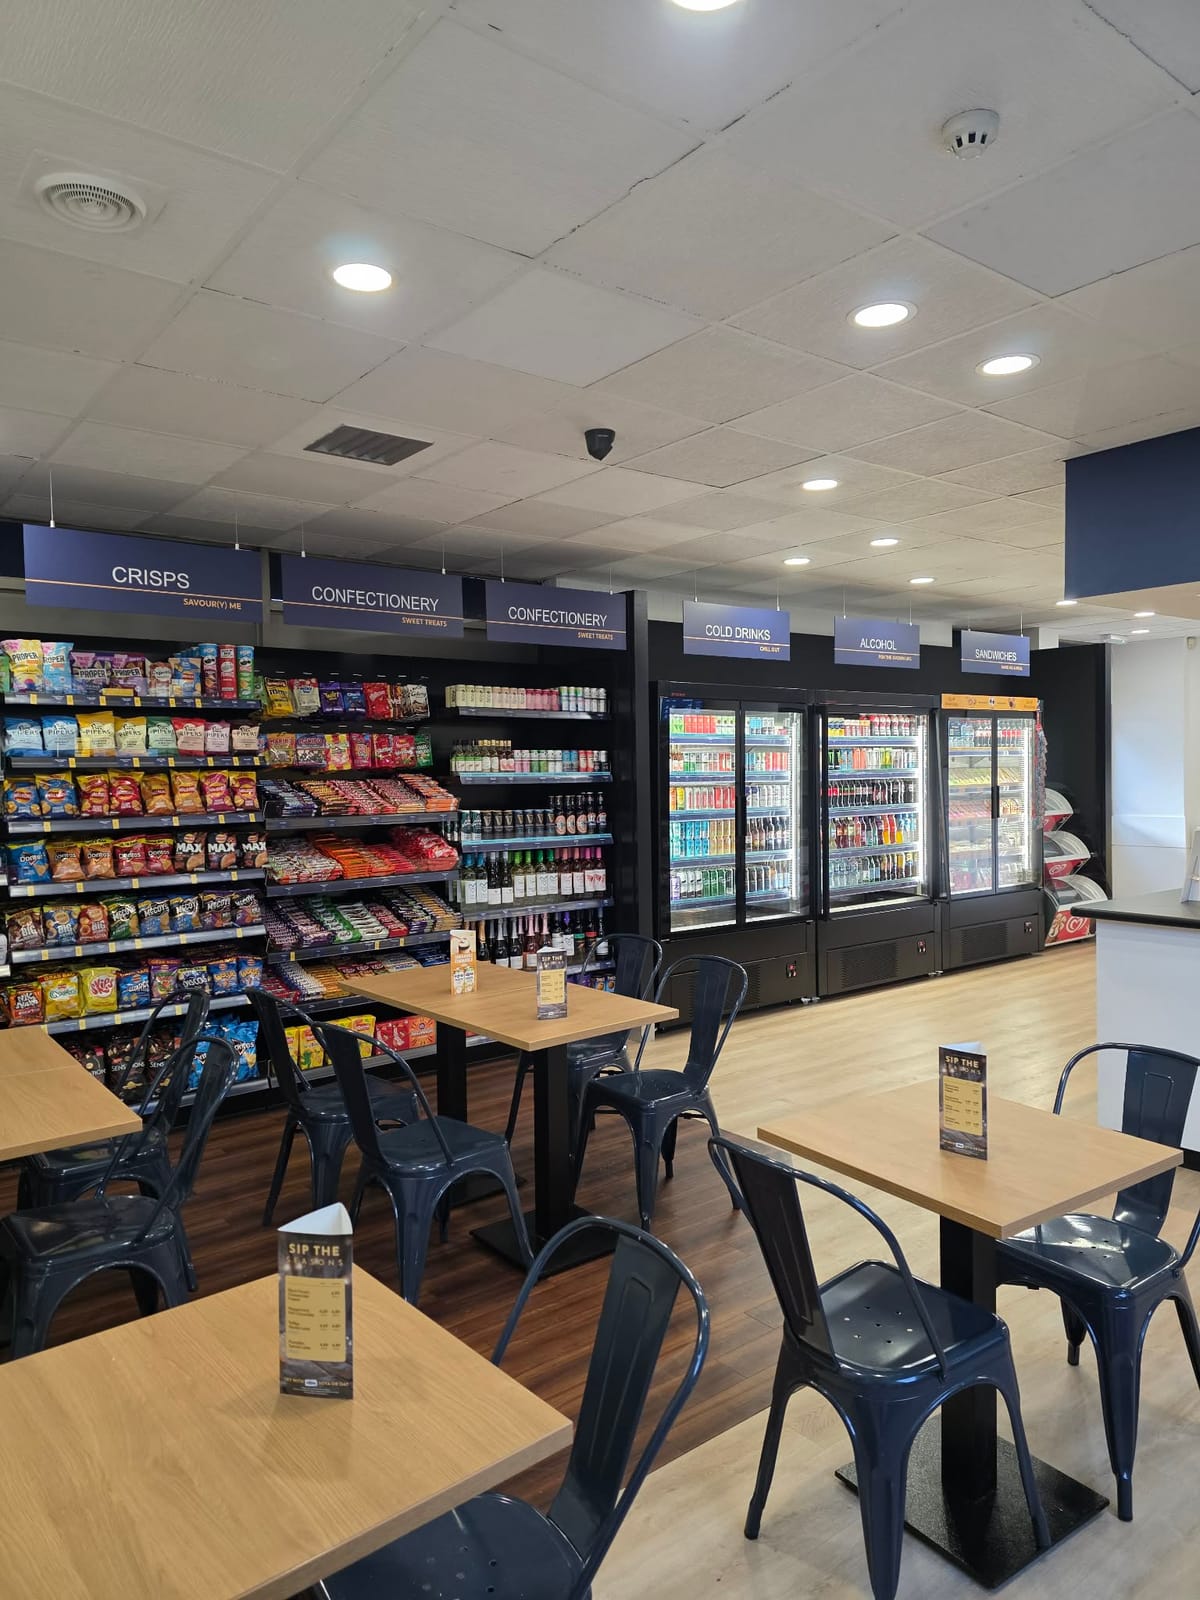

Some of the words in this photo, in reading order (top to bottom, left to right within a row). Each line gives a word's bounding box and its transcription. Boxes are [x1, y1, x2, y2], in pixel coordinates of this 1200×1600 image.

[112, 566, 190, 589] CRISPS
[183, 598, 228, 610] SAVOUR(Y)
[229, 602, 242, 610] ME
[311, 586, 439, 612] CONFECTIONERY
[402, 616, 423, 626] SWEET
[425, 618, 448, 627] TREATS
[508, 606, 608, 627] CONFECTIONERY
[577, 631, 596, 639] SWEET
[705, 624, 733, 638] COLD
[735, 627, 771, 641] DRINKS
[860, 638, 897, 650] ALCOHOL
[12, 651, 38, 662] PROPER
[975, 648, 1017, 662] SANDWICHES
[80, 669, 106, 678] PROPER
[176, 842, 202, 853] MAX
[208, 842, 235, 853] MAX
[242, 841, 267, 853] MAX
[945, 1055, 960, 1065] SIP
[961, 1058, 980, 1069] THE
[288, 1243, 310, 1255] SIP
[313, 1245, 341, 1257] THE
[286, 1255, 344, 1267] SEASONS
